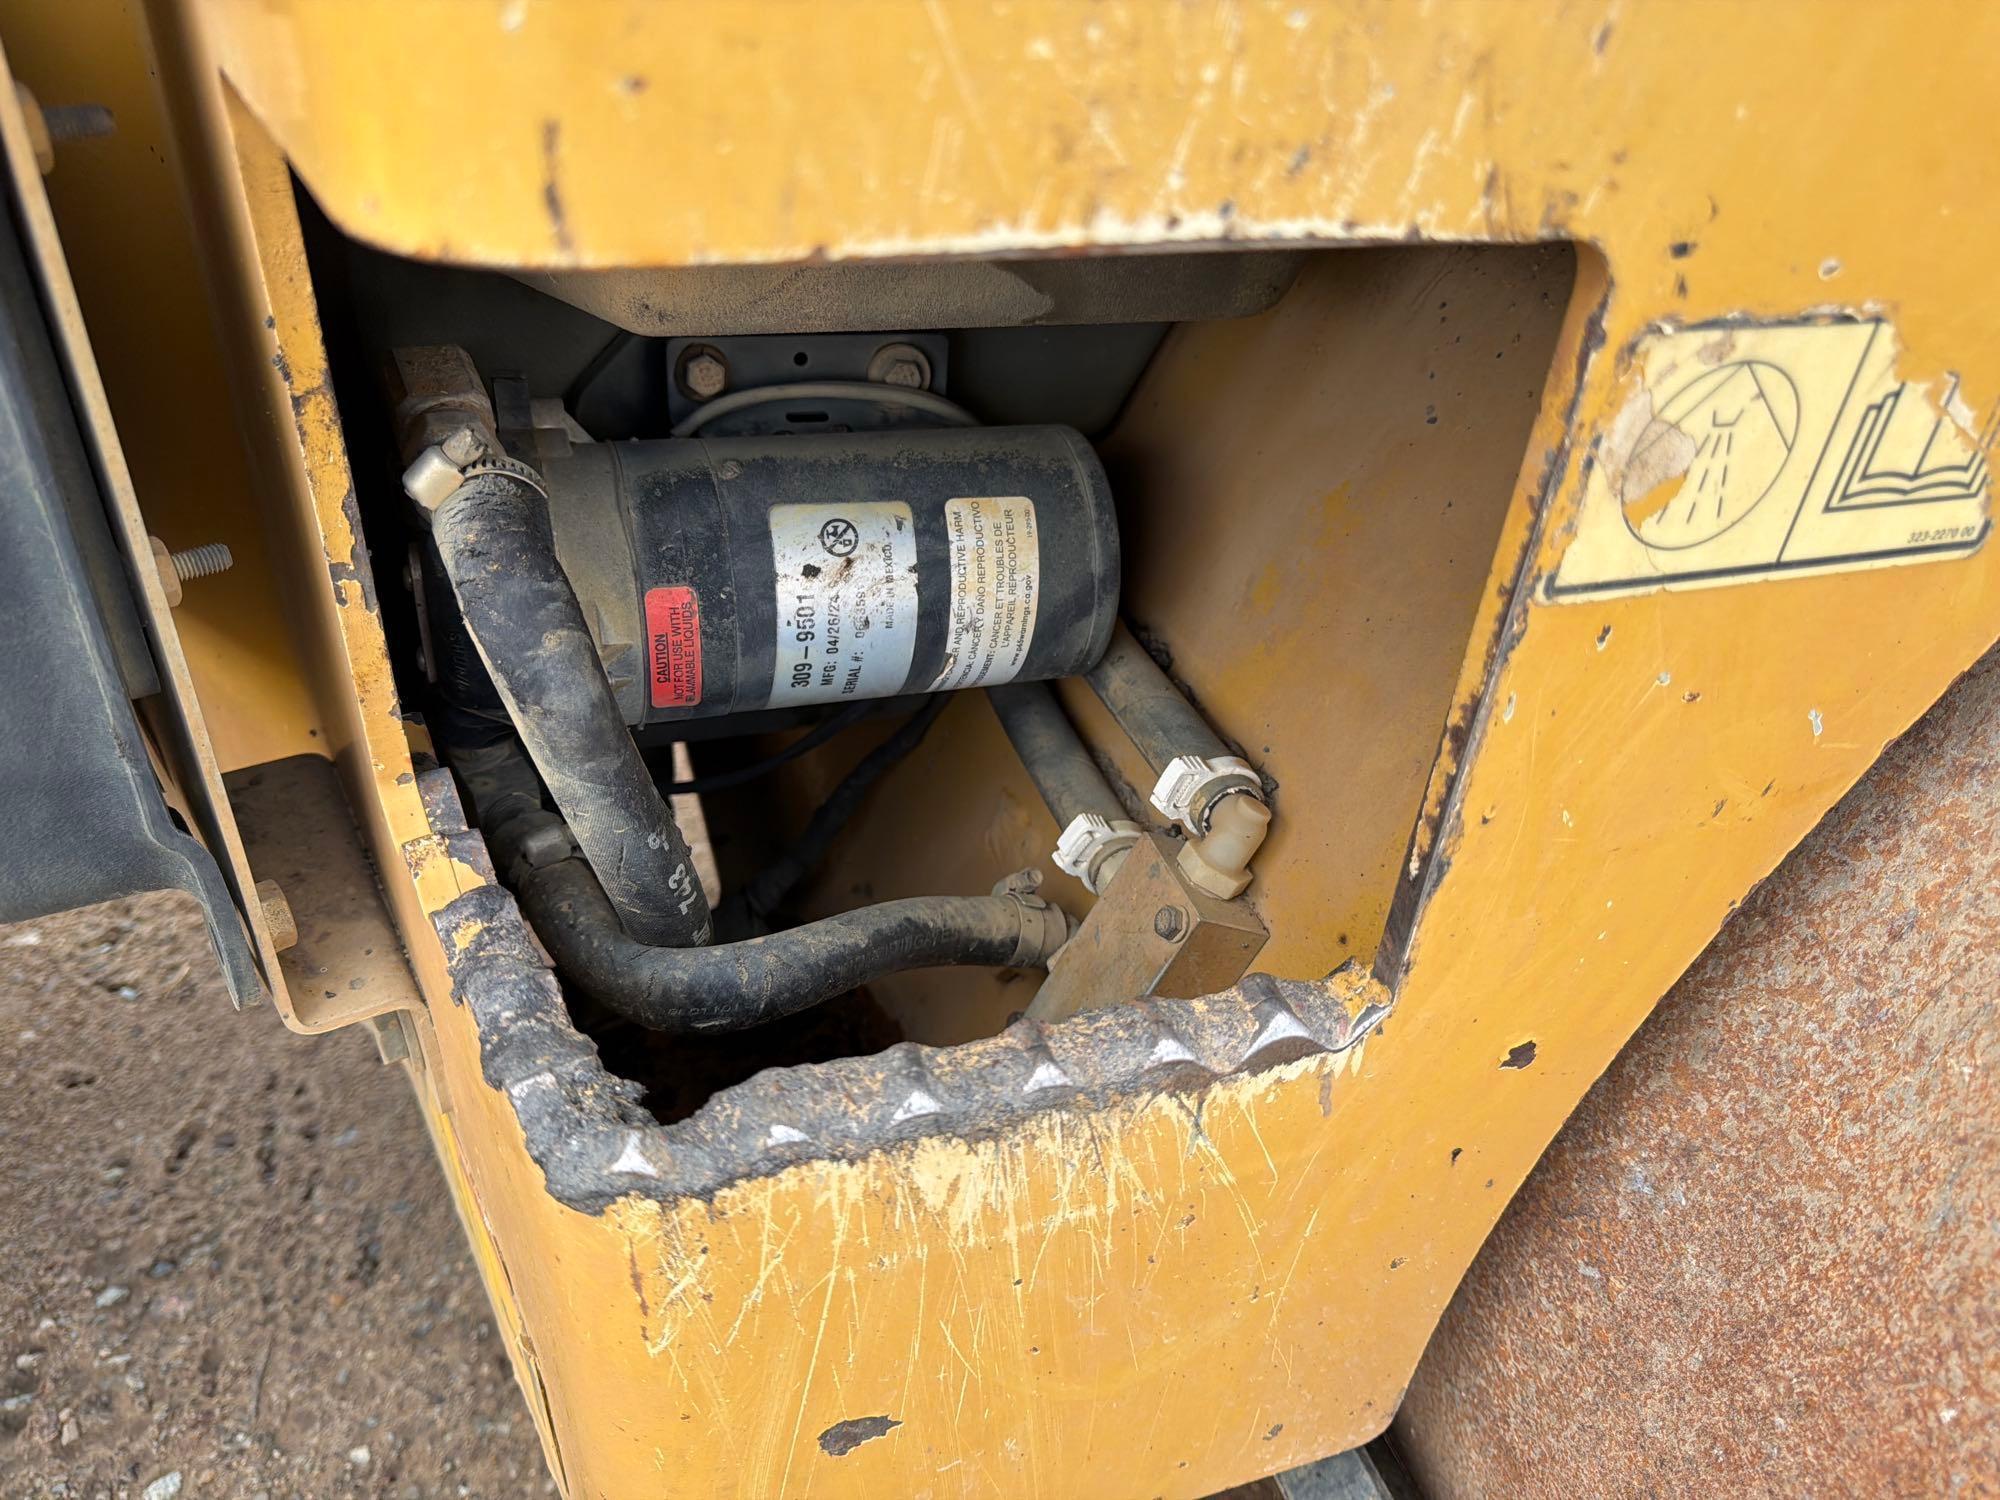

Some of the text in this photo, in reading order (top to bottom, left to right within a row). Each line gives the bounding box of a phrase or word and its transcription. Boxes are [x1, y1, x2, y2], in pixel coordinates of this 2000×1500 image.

[953, 511, 964, 542] HARM
[970, 501, 986, 583] REPRODUCTIVO
[993, 522, 1003, 537] DE
[994, 539, 1005, 594] TROUBLES
[1001, 509, 1017, 648] L'APPAREIL REPRODUCTEUR
[884, 587, 896, 599] IN
[955, 544, 967, 623] REPRODUCTIVE
[884, 602, 895, 629] MADE
[974, 586, 986, 614] DAÑO
[994, 598, 1004, 610] ET
[681, 602, 694, 648] LIQUIDS
[953, 627, 963, 645] AND
[989, 612, 1003, 649] CANCER
[1010, 575, 1033, 667] www.p65warnings.ca.gov
[654, 634, 669, 684] CAUTION
[669, 607, 684, 700] NOT FOR USE WITH
[851, 651, 864, 662] #:
[821, 661, 838, 686] MFG:
[842, 665, 862, 695] SERIAL
